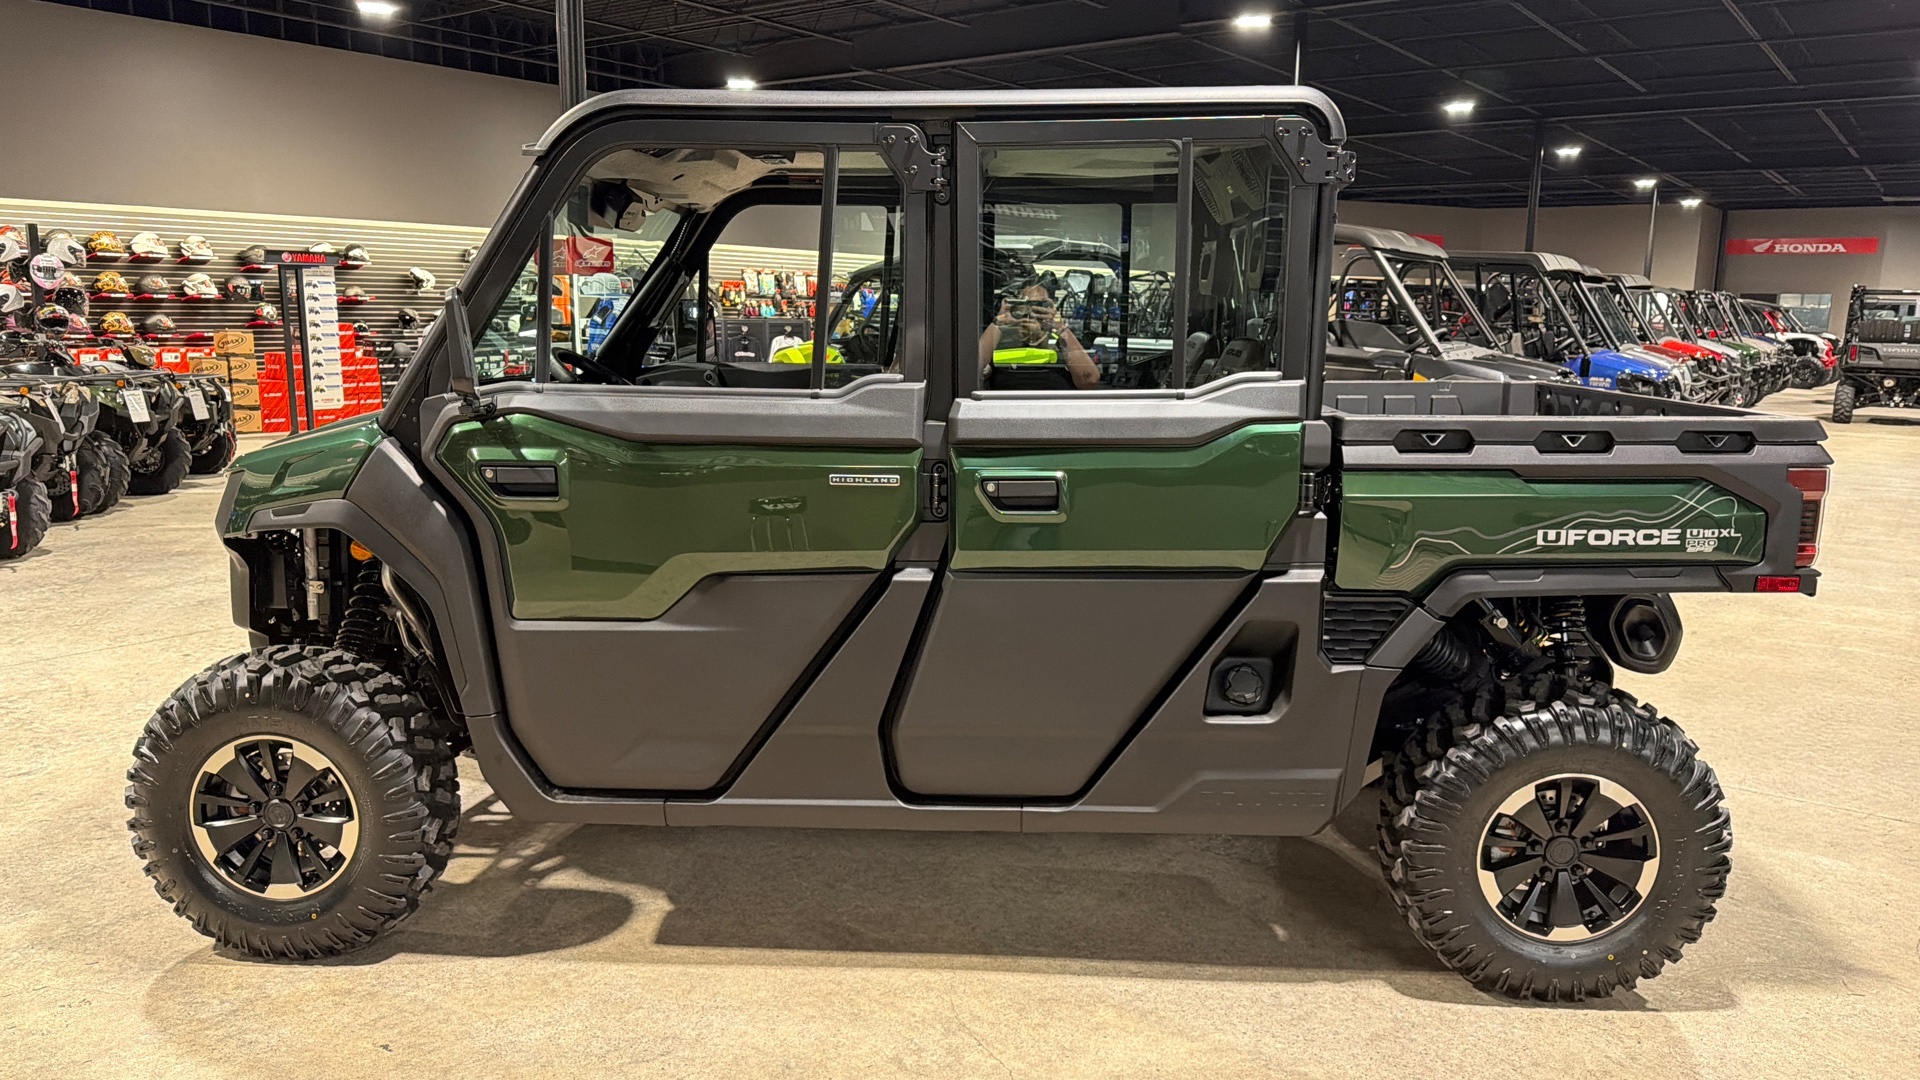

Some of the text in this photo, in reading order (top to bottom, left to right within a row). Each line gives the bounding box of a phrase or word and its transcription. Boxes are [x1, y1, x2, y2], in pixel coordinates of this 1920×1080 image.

[1773, 243, 1847, 253] HONDA
[291, 253, 326, 263] YAMAHA
[1536, 528, 1682, 546] UFORCE
[1685, 538, 1718, 548] PRO
